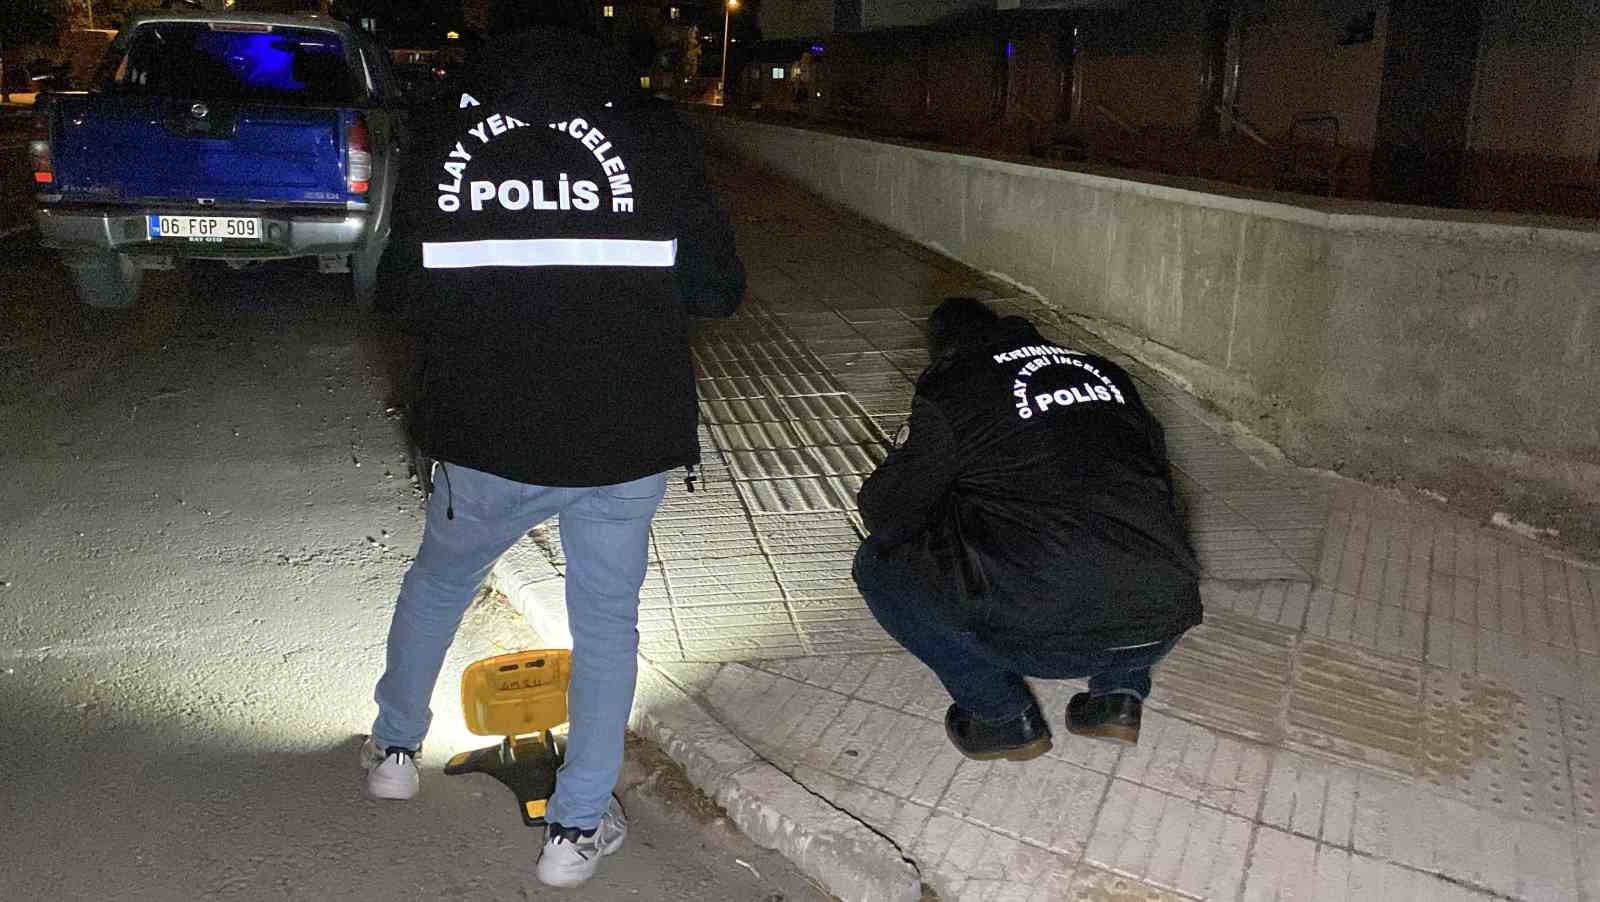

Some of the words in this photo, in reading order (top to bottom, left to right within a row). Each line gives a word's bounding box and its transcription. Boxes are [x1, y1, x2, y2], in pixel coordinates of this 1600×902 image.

[437, 141, 472, 212] OLAY
[468, 113, 530, 143] YE
[549, 118, 634, 213] CELEME
[470, 172, 600, 211] POLİS
[161, 218, 180, 234] 06
[189, 218, 217, 235] FGP
[227, 219, 255, 236] 509
[1018, 355, 1051, 377] YERİ
[1013, 378, 1033, 419] OLAY
[1034, 382, 1112, 412] POLİS
